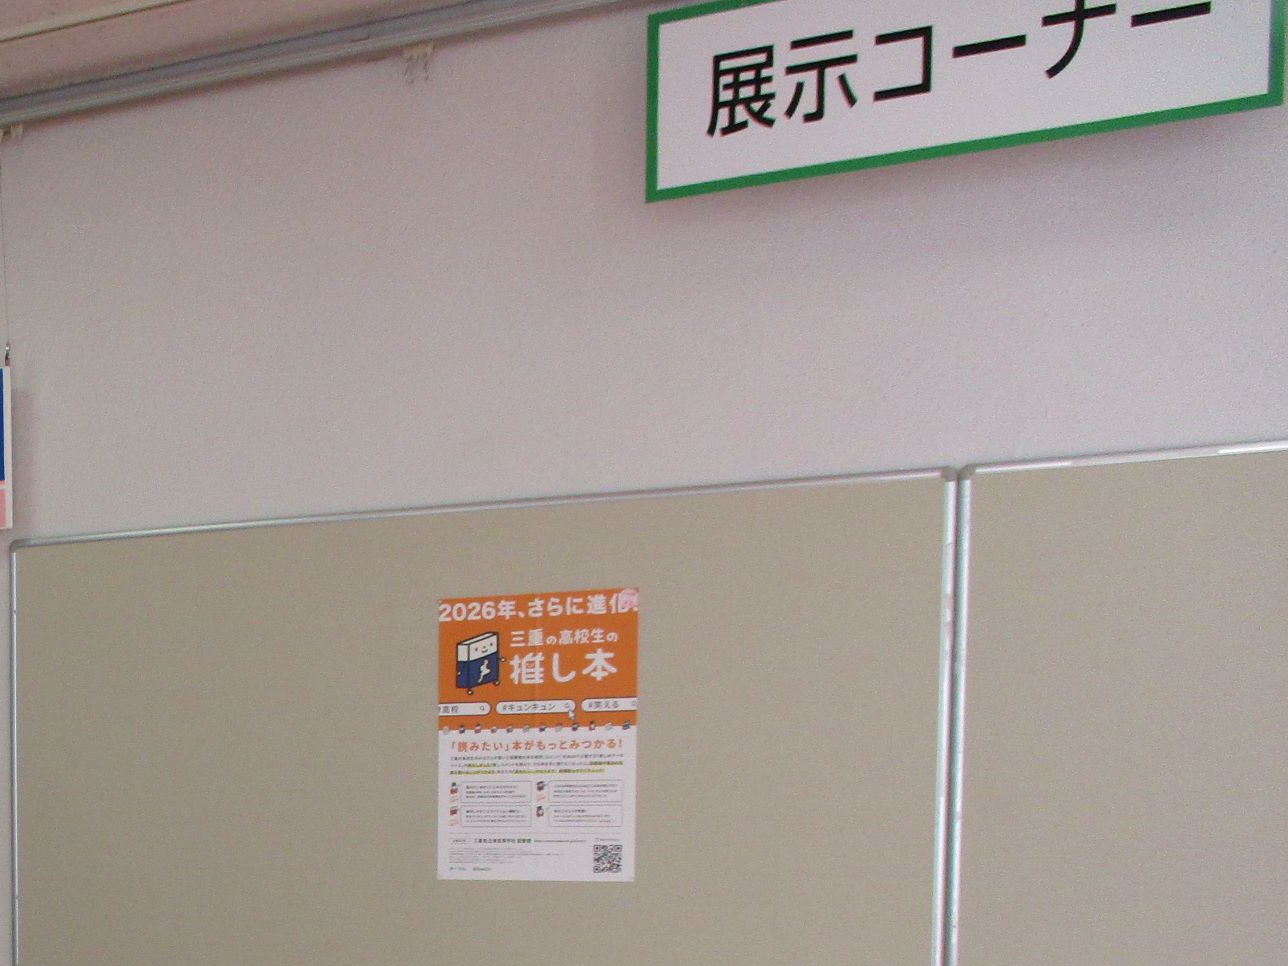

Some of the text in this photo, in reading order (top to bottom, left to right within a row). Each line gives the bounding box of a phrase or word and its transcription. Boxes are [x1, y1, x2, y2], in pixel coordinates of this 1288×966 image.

[706, 0, 1211, 137] 展示コーナー
[510, 627, 619, 648] 三重の高校生の
[509, 648, 618, 685] 推し本
